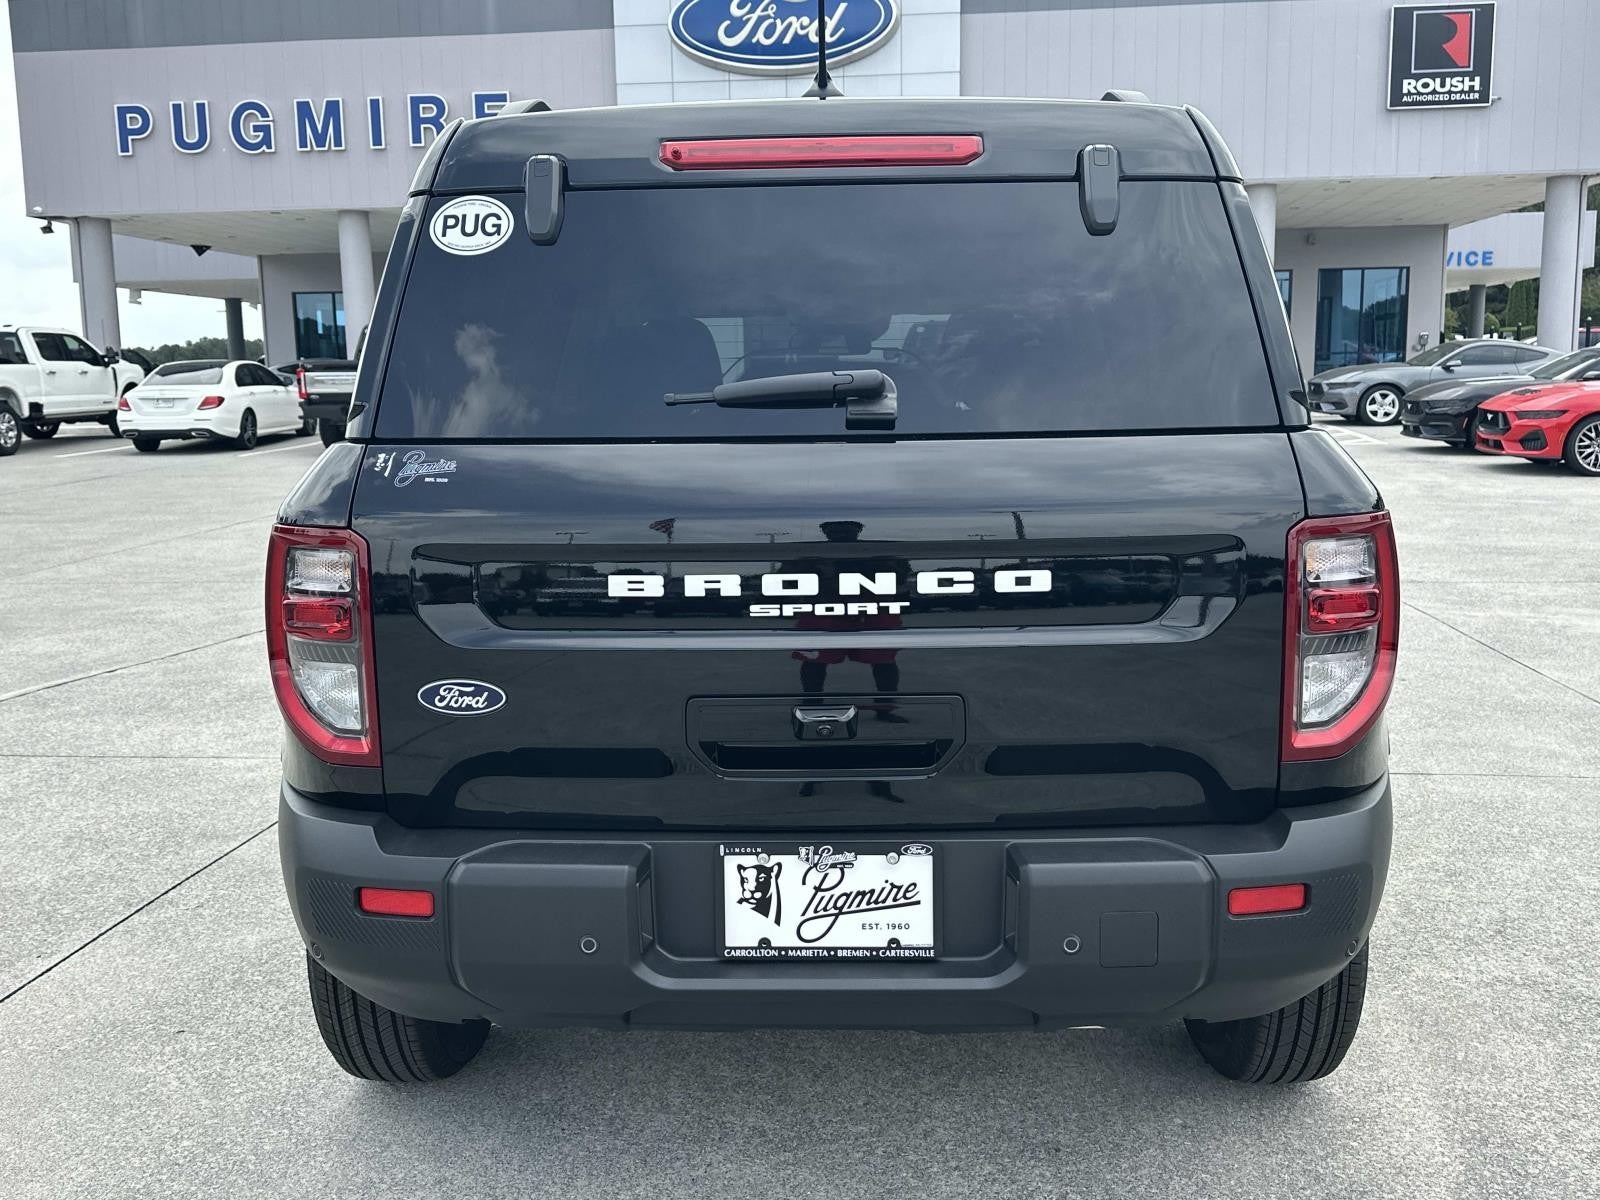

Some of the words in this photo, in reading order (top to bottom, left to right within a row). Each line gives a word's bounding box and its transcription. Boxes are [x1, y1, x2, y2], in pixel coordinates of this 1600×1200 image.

[717, 0, 848, 47] Ford
[1402, 76, 1481, 94] ROUSH
[1402, 94, 1450, 102] AUTHORIZED
[1450, 93, 1480, 101] DEALER
[441, 213, 503, 238] PUG
[607, 569, 1053, 598] BRONCO
[749, 601, 911, 617] SPORT
[434, 684, 489, 709] Ford
[725, 846, 763, 854] LINCOLN
[816, 845, 858, 873] Pugmire
[906, 845, 928, 855] Ford
[796, 865, 922, 944] Pugmire
[861, 922, 883, 931] EST.
[886, 922, 911, 931] 1960
[724, 949, 780, 958] CARROLLTON
[787, 949, 830, 958] MARIETTA
[837, 949, 871, 958] BREMEN
[879, 949, 936, 958] CARTERSVILLE
